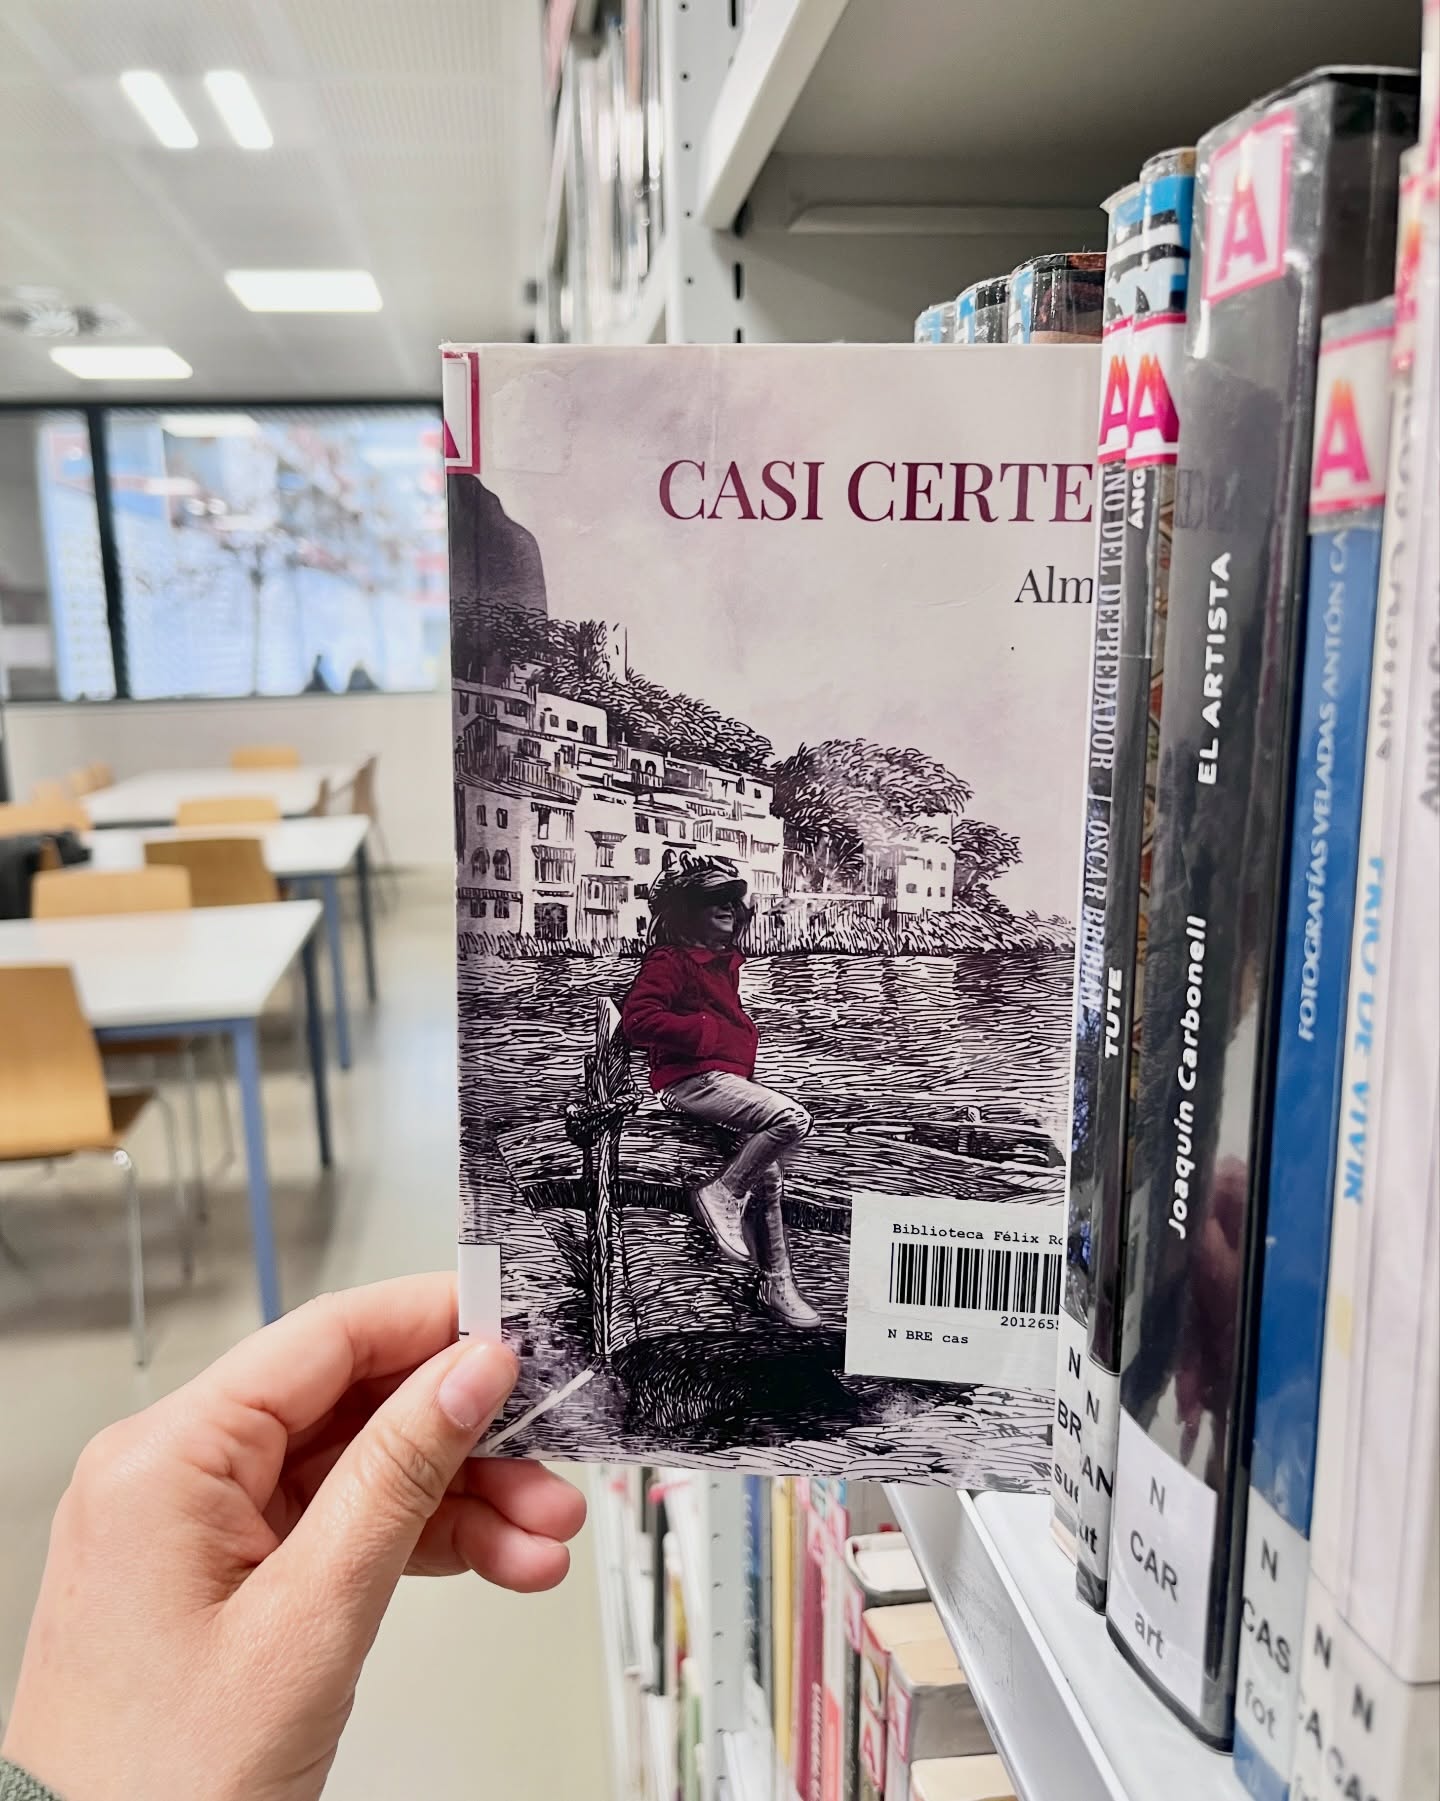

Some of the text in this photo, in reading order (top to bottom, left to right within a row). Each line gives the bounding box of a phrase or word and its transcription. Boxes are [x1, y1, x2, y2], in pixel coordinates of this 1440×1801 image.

[1127, 352, 1180, 448] A
[1314, 377, 1371, 489] A
[659, 459, 1093, 523] CASI CERTE
[1101, 520, 1124, 575] DEL
[1202, 551, 1232, 729] ARTISTA
[1090, 583, 1121, 771] DEPREDADOR
[1197, 737, 1219, 786] EL
[1312, 702, 1337, 837] VELADAS
[1298, 839, 1330, 1042] FOTOGRAFÍAS
[1104, 966, 1123, 1059] TUTE
[1177, 915, 1208, 1092] Carbonell
[892, 1223, 984, 1241] Biblioteca
[993, 1231, 1040, 1244] Félix
[887, 1328, 969, 1344] N BRE cas
[1068, 1346, 1081, 1379] N
[1086, 1390, 1100, 1424] N
[1149, 1475, 1166, 1515] N
[1130, 1529, 1178, 1602] CAR
[1261, 1537, 1278, 1582] N
[1135, 1611, 1164, 1659] art
[1242, 1596, 1291, 1674] CAS
[1314, 1624, 1332, 1670] N
[1352, 1683, 1374, 1734] N
